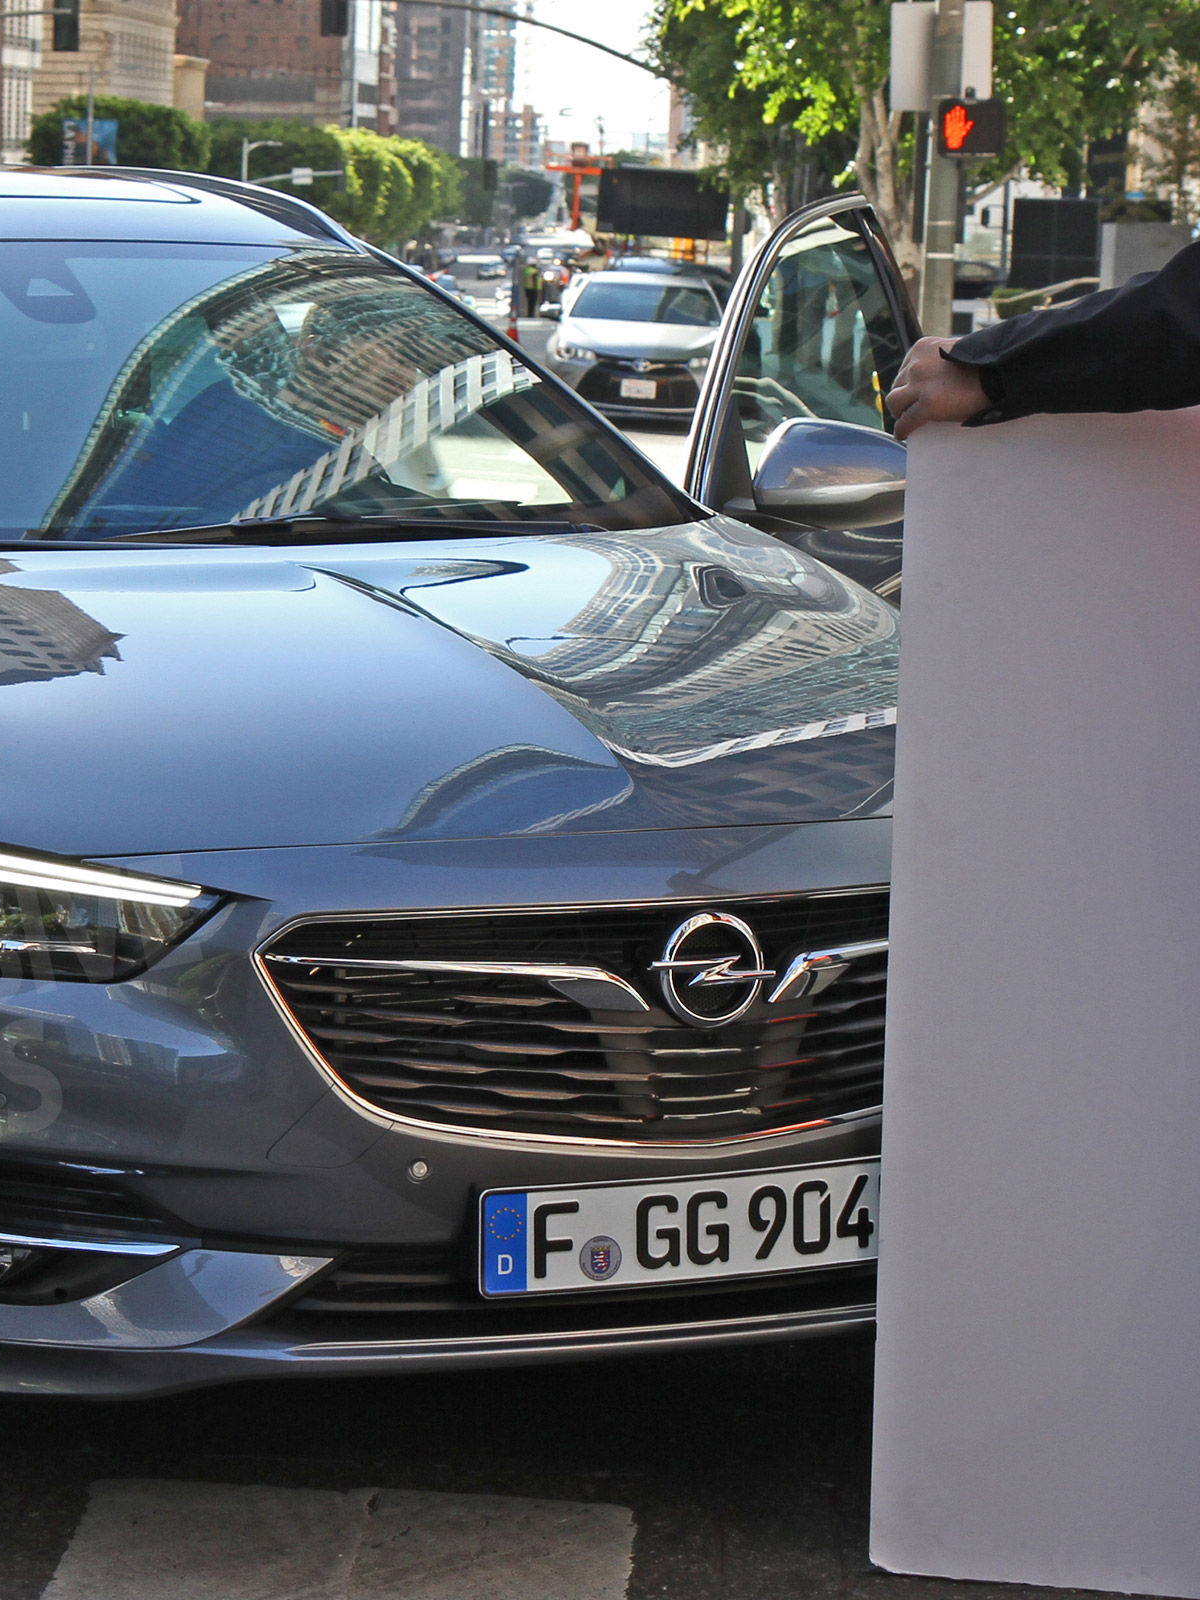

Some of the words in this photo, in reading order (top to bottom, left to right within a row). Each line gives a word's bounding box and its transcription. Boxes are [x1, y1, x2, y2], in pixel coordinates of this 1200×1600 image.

[534, 1200, 580, 1279] F
[636, 1190, 730, 1269] GG
[748, 1174, 881, 1259] 904
[497, 1254, 514, 1275] D
